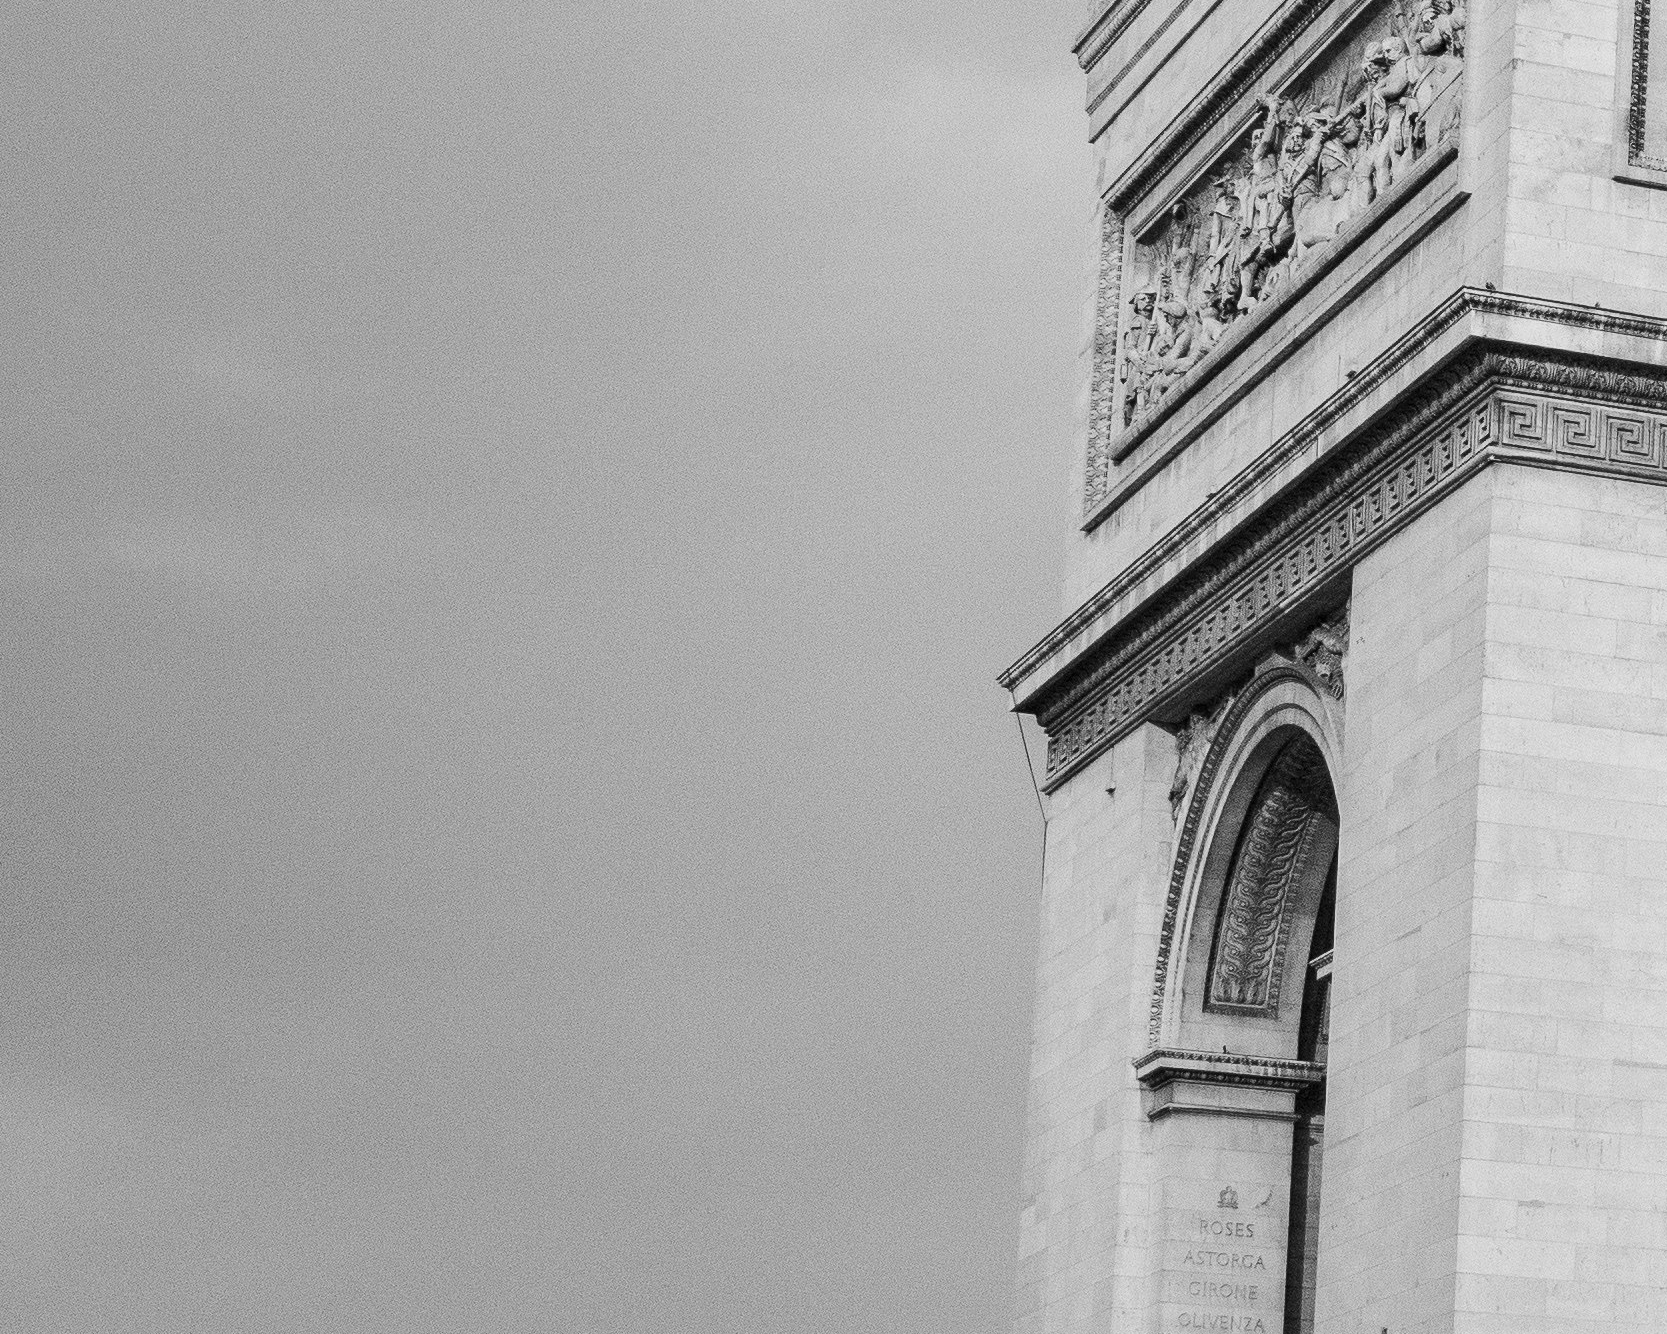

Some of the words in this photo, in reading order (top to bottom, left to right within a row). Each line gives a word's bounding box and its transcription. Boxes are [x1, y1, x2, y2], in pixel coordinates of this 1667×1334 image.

[1199, 1219, 1255, 1239] ROSES
[1182, 1250, 1266, 1271] ASTORGA
[1188, 1280, 1258, 1302] GIRONE
[1177, 1312, 1266, 1334] OLIVENZA
